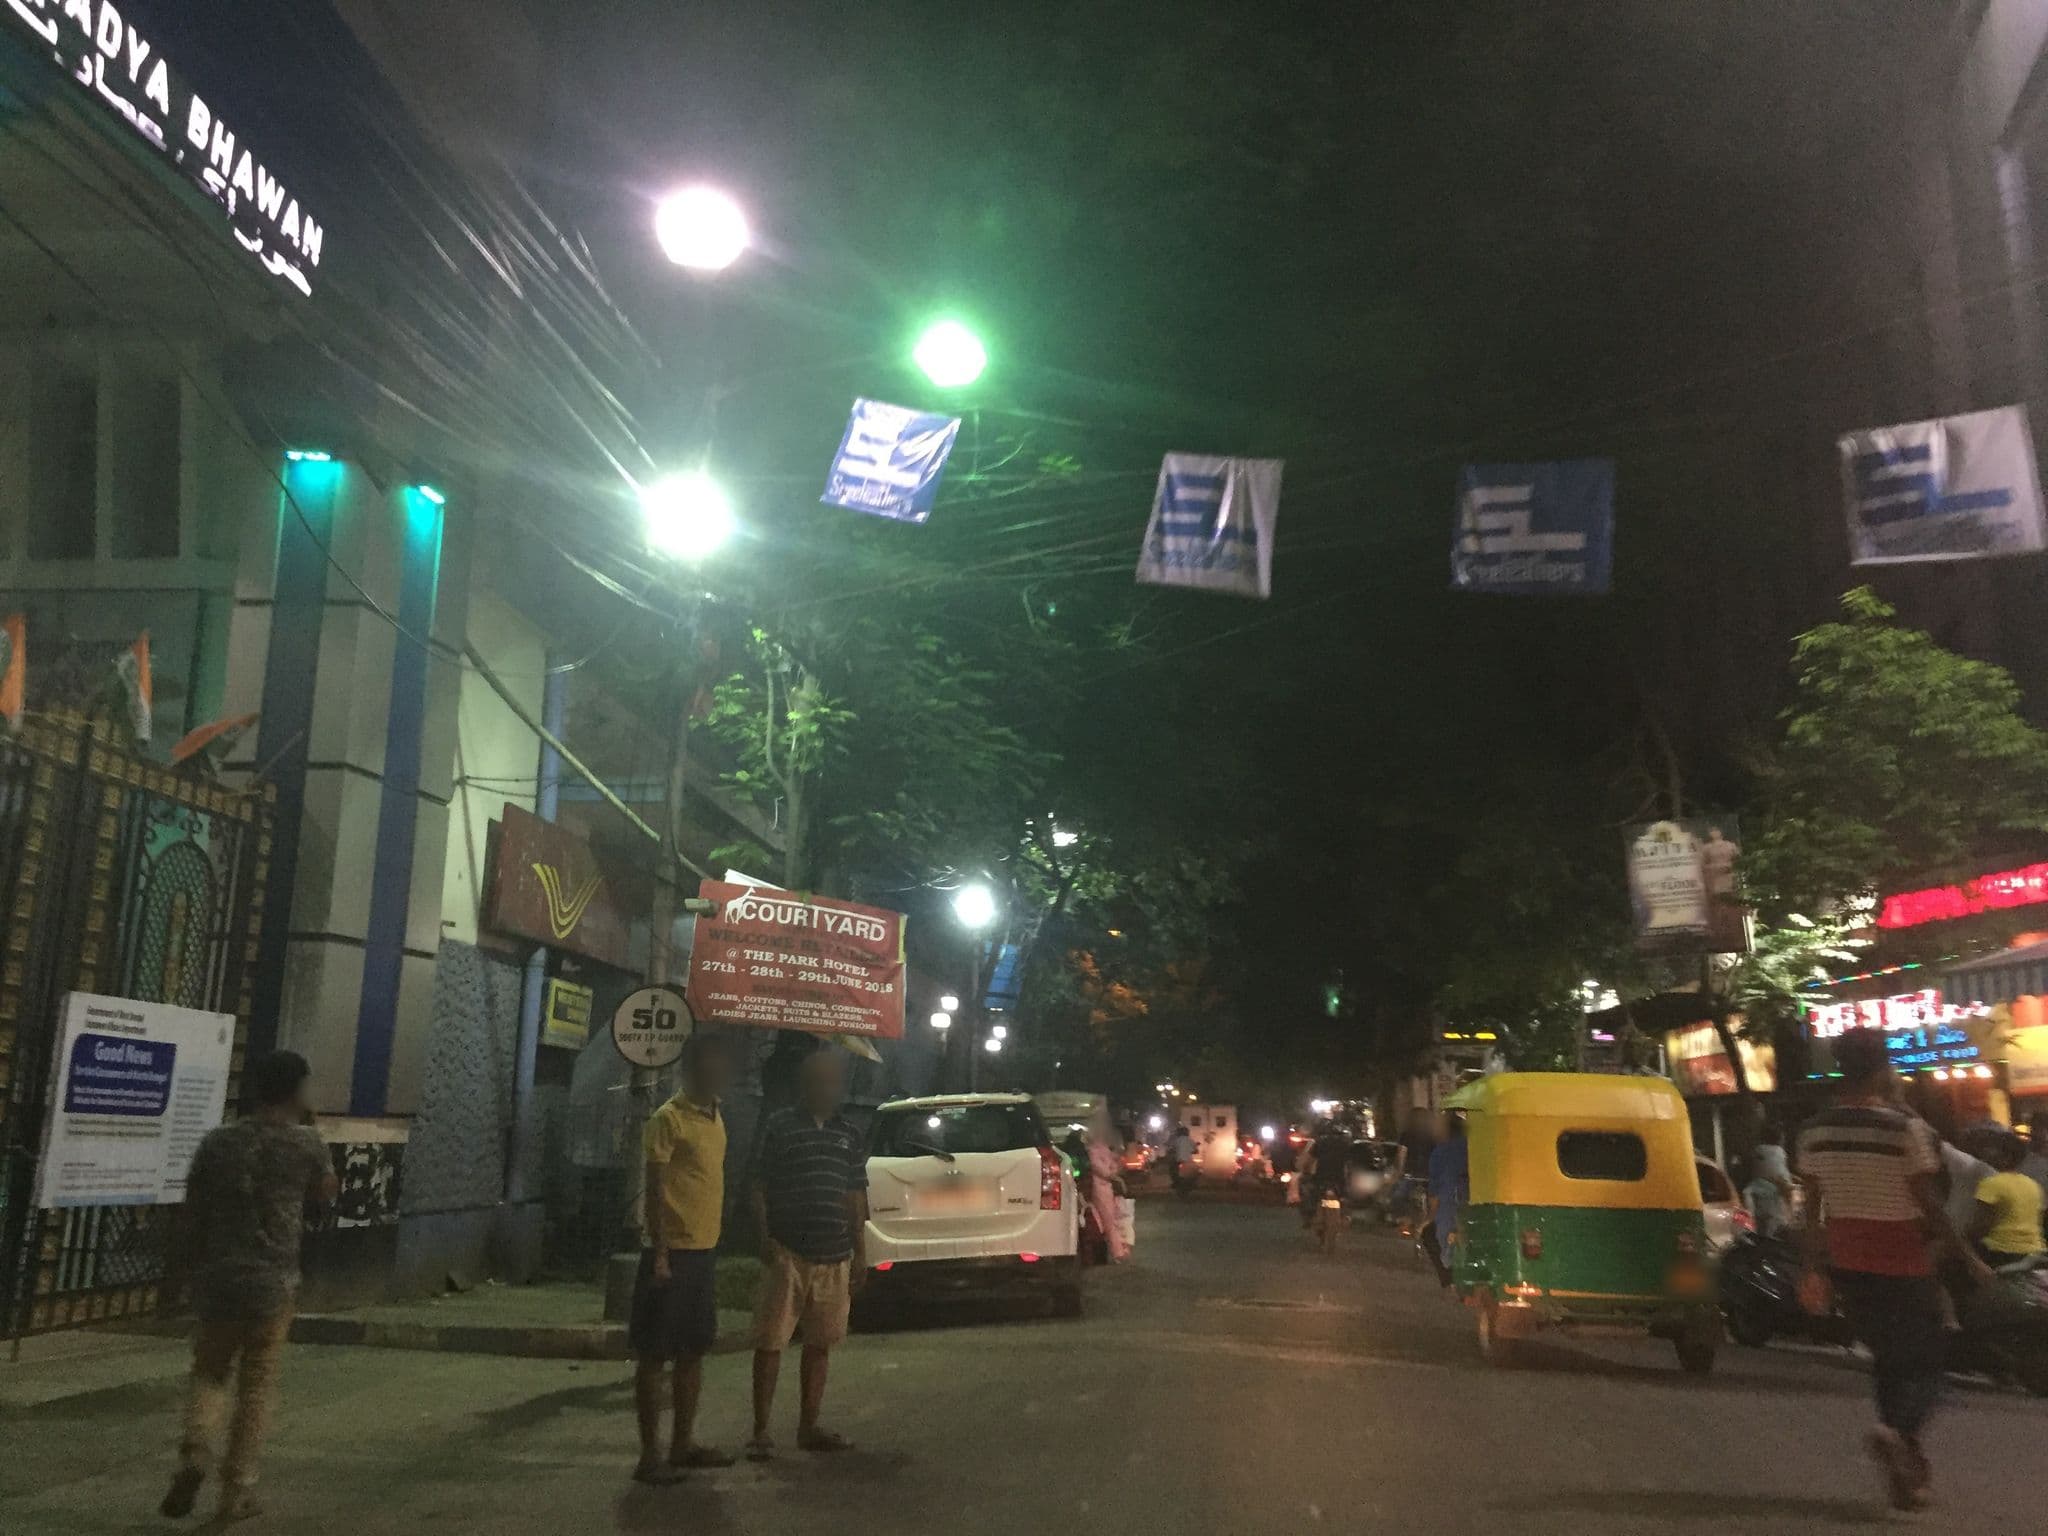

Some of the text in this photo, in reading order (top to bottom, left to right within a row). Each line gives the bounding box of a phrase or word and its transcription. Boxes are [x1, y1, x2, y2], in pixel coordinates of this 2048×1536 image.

[27, 0, 324, 267] ADYA BHAWAN
[742, 899, 886, 941] COURTYARD
[702, 960, 736, 974] 27th
[750, 965, 784, 978] 28th
[798, 970, 831, 984] 29th
[832, 974, 862, 990] JUNE
[864, 980, 894, 993] 2018
[726, 948, 870, 977] @ THE PARK HOTEL
[632, 1008, 676, 1030] 50
